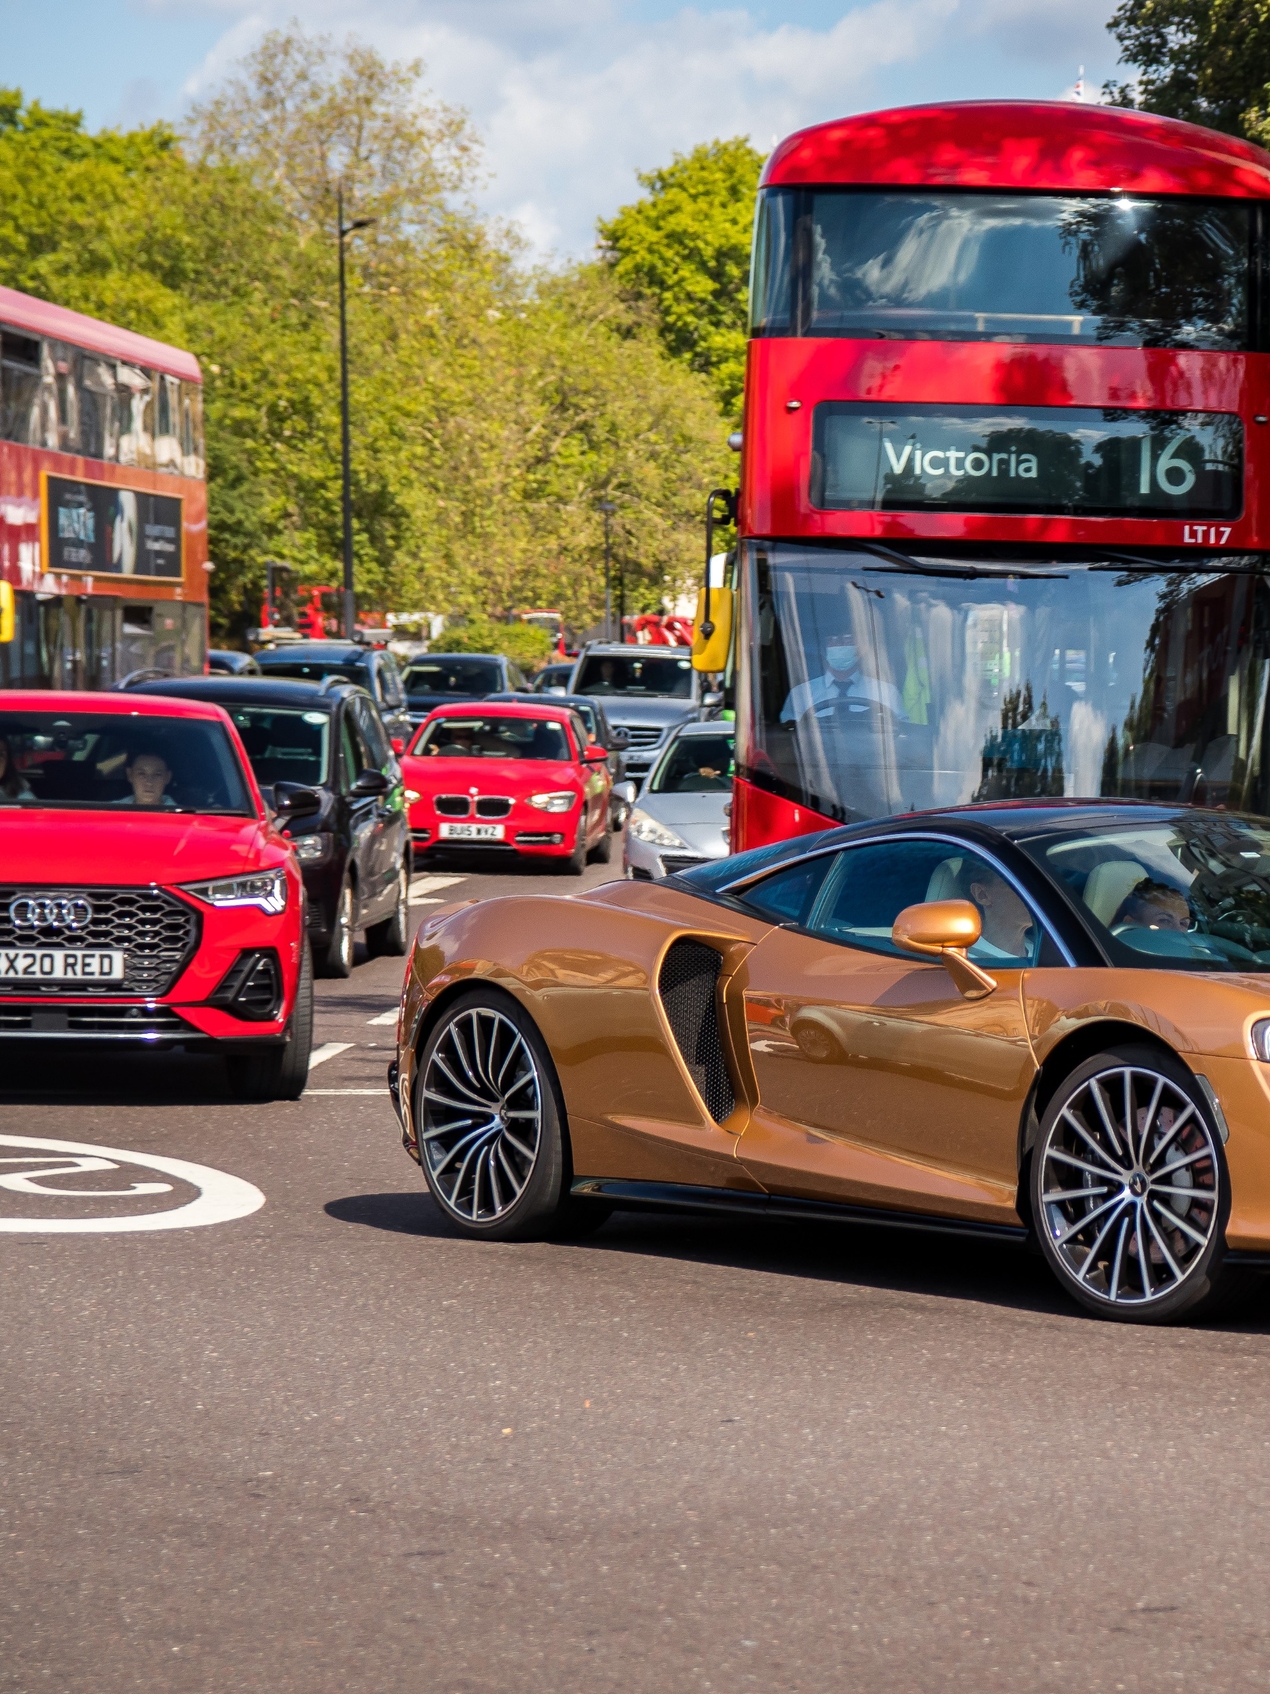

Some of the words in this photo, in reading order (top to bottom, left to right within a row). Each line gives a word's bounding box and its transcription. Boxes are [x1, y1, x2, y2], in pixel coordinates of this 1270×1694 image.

[883, 437, 1038, 478] Victoria
[1139, 435, 1196, 495] 16
[1183, 525, 1232, 544] LT17
[0, 953, 54, 975] X20
[63, 953, 113, 976] RED
